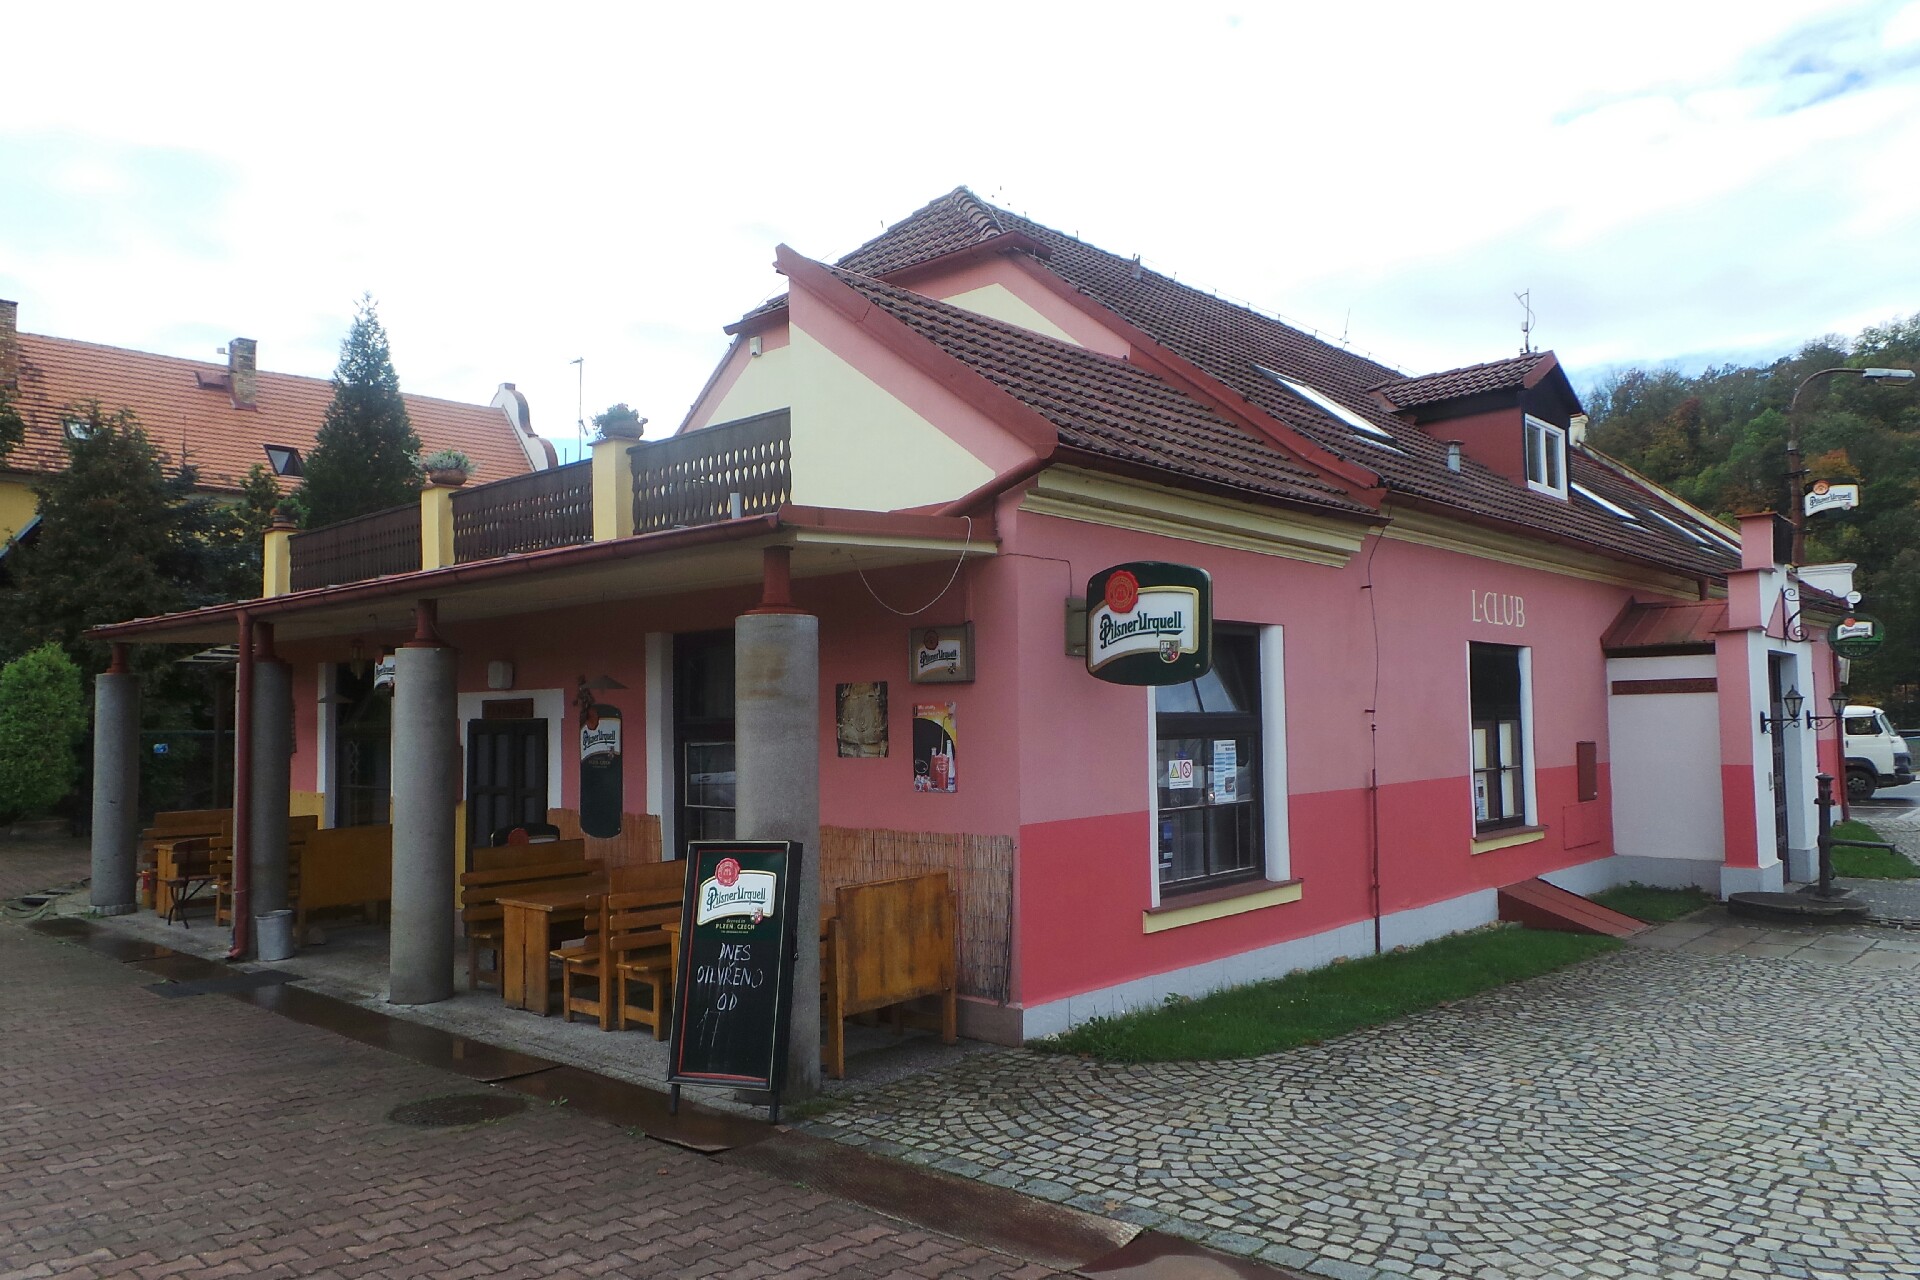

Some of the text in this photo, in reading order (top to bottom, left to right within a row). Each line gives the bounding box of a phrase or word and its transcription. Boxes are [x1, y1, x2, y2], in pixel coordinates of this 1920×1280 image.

[1099, 610, 1182, 649] Pilsner Urquell
[706, 885, 766, 911] Pilsner Urquell
[718, 943, 751, 961] DNES
[717, 993, 738, 1011] OD
